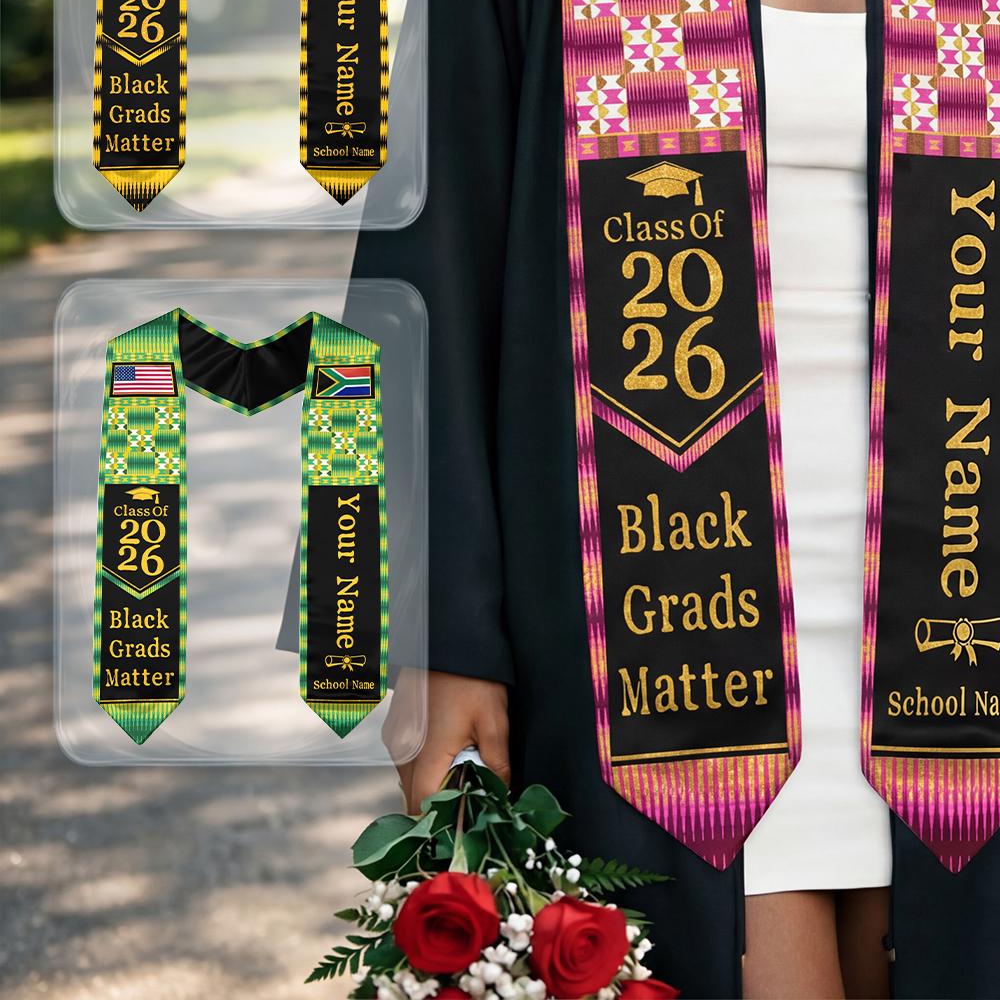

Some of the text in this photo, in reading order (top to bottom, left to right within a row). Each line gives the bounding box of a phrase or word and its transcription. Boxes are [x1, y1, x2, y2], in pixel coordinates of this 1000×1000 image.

[118, 12, 164, 43] 26
[110, 72, 169, 94] Black
[337, 43, 358, 115] Name
[110, 102, 170, 123] Grads
[106, 135, 174, 152] Matter
[314, 146, 374, 156] School Name
[622, 248, 723, 318] 20
[622, 316, 725, 400] 26
[941, 180, 995, 597] Your Name
[120, 519, 166, 544] 20
[617, 491, 752, 553] Black
[118, 545, 164, 576] 26
[336, 493, 360, 648] Your Name
[110, 607, 169, 628] Black
[624, 573, 759, 634] Grads
[109, 637, 170, 658] Grads
[106, 669, 174, 687] Matter
[314, 679, 374, 689] School Name
[619, 663, 773, 716] Matter
[888, 687, 966, 716] School
